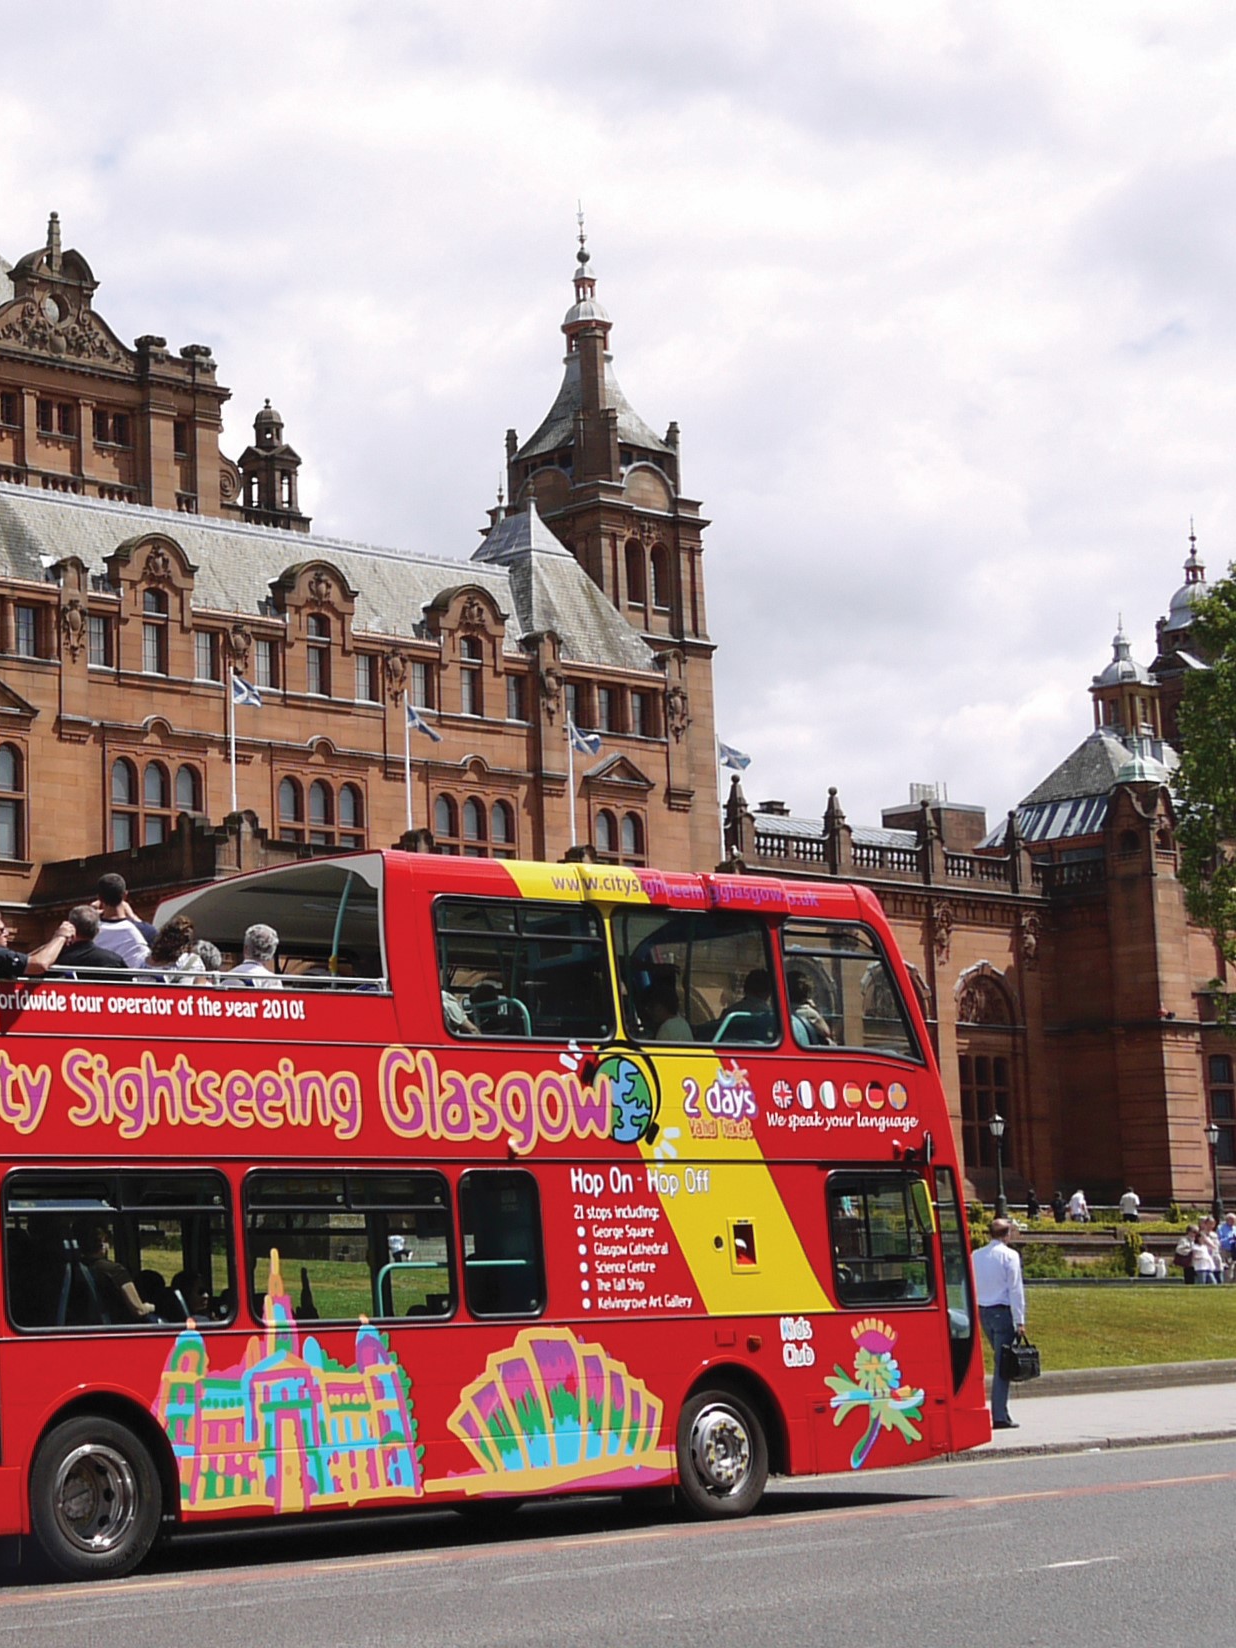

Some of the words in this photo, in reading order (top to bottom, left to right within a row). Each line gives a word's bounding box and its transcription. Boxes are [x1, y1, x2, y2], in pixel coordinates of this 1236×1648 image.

[69, 994, 104, 1014] tour
[108, 995, 174, 1016] operator
[178, 995, 194, 1016] of
[197, 996, 221, 1017] the
[224, 1000, 257, 1020] year
[262, 1000, 305, 1020] 2010!
[62, 1046, 362, 1140] Sightseeing
[378, 1044, 613, 1155] Glasgow
[683, 1079, 700, 1115] 2
[706, 1078, 756, 1119] days
[766, 1112, 786, 1127] We
[788, 1111, 823, 1131] speak
[825, 1114, 854, 1132] your
[856, 1111, 919, 1132] language
[570, 1167, 604, 1198] Hop
[609, 1166, 633, 1193] On
[646, 1168, 679, 1198] Hop
[685, 1167, 710, 1193] Off
[574, 1204, 584, 1219] 21
[586, 1205, 612, 1221] stops
[615, 1204, 660, 1221] including:
[592, 1225, 624, 1239] George
[625, 1224, 655, 1239] Square
[594, 1242, 628, 1257] Glasgow
[629, 1242, 669, 1255] Cathedral
[595, 1260, 626, 1274] Science
[627, 1260, 656, 1273] Centre
[596, 1278, 611, 1291] The
[613, 1278, 625, 1291] Tall
[627, 1278, 645, 1292] Ship
[597, 1296, 647, 1311] Kelvingrove
[648, 1295, 663, 1308] Art
[664, 1294, 692, 1309] Gallery
[780, 1316, 813, 1341] Kids
[782, 1342, 815, 1367] Club
